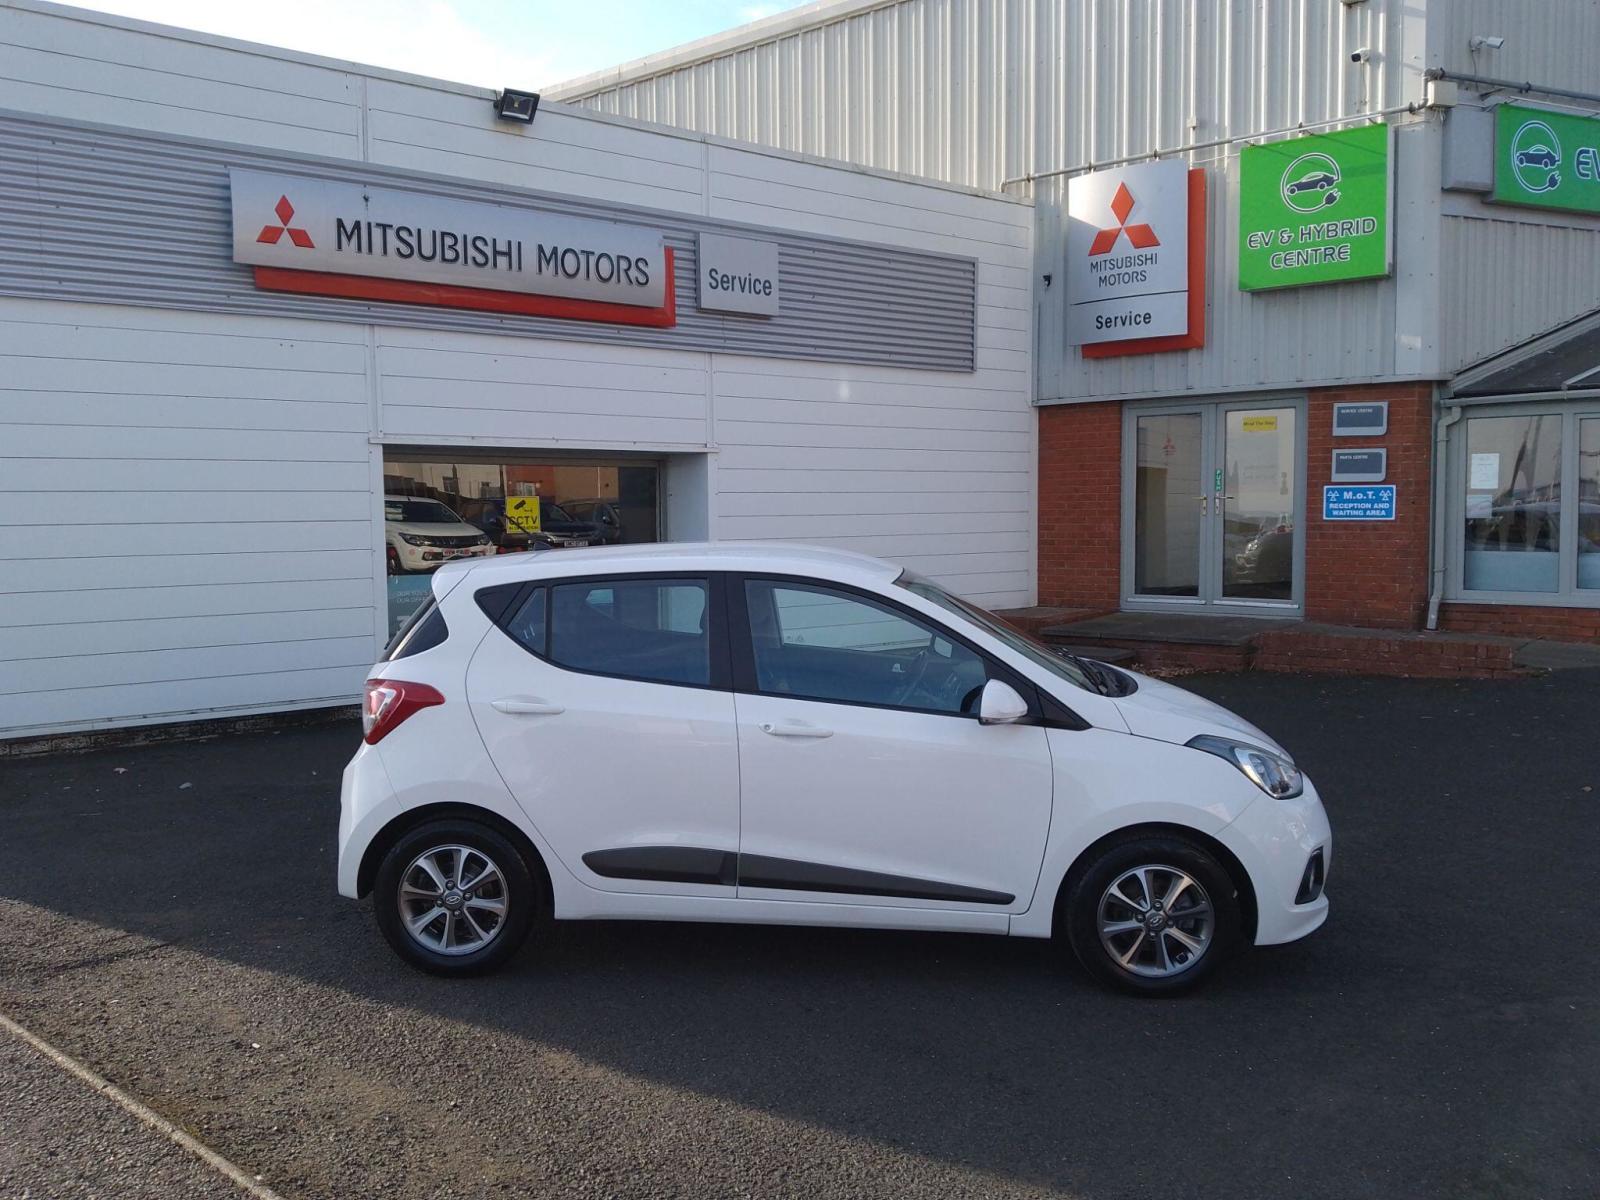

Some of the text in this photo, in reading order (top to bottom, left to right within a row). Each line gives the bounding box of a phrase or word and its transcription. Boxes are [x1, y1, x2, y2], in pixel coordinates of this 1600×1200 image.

[1247, 216, 1377, 250] EV & HYBRID
[336, 217, 650, 286] MITSUBISHI MOTORS
[1090, 253, 1158, 273] MITSUBISHI
[1270, 243, 1350, 270] CENTRE
[708, 267, 772, 296] Service
[1099, 270, 1147, 288] MOTORS
[1095, 310, 1152, 330] Service
[509, 515, 538, 525] CCTV
